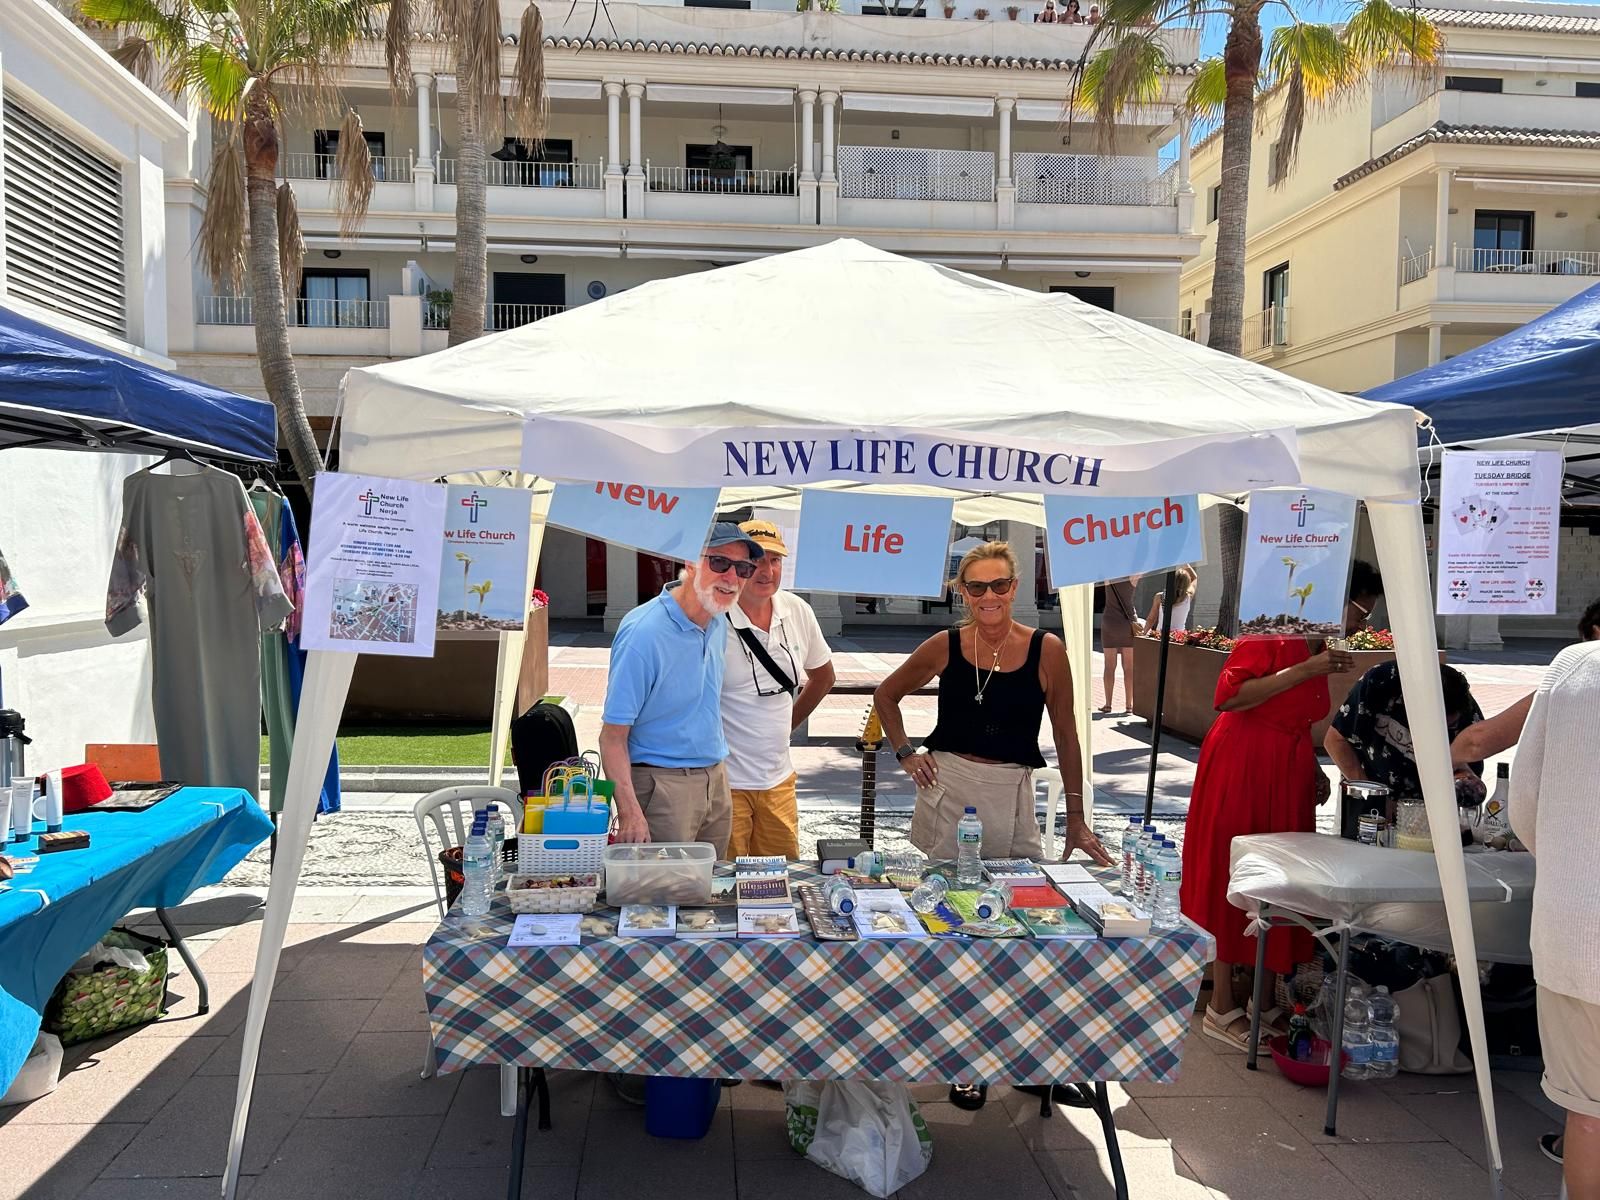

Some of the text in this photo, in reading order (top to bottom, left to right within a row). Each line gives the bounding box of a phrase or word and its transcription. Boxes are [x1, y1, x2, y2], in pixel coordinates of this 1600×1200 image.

[722, 438, 1105, 487] NEW LIFE CHURCH
[379, 500, 404, 508] Church
[1063, 497, 1184, 545] Church
[457, 529, 476, 538] Life
[479, 530, 515, 540] Church
[844, 524, 904, 554] Life
[1260, 533, 1339, 543] New Life Church
